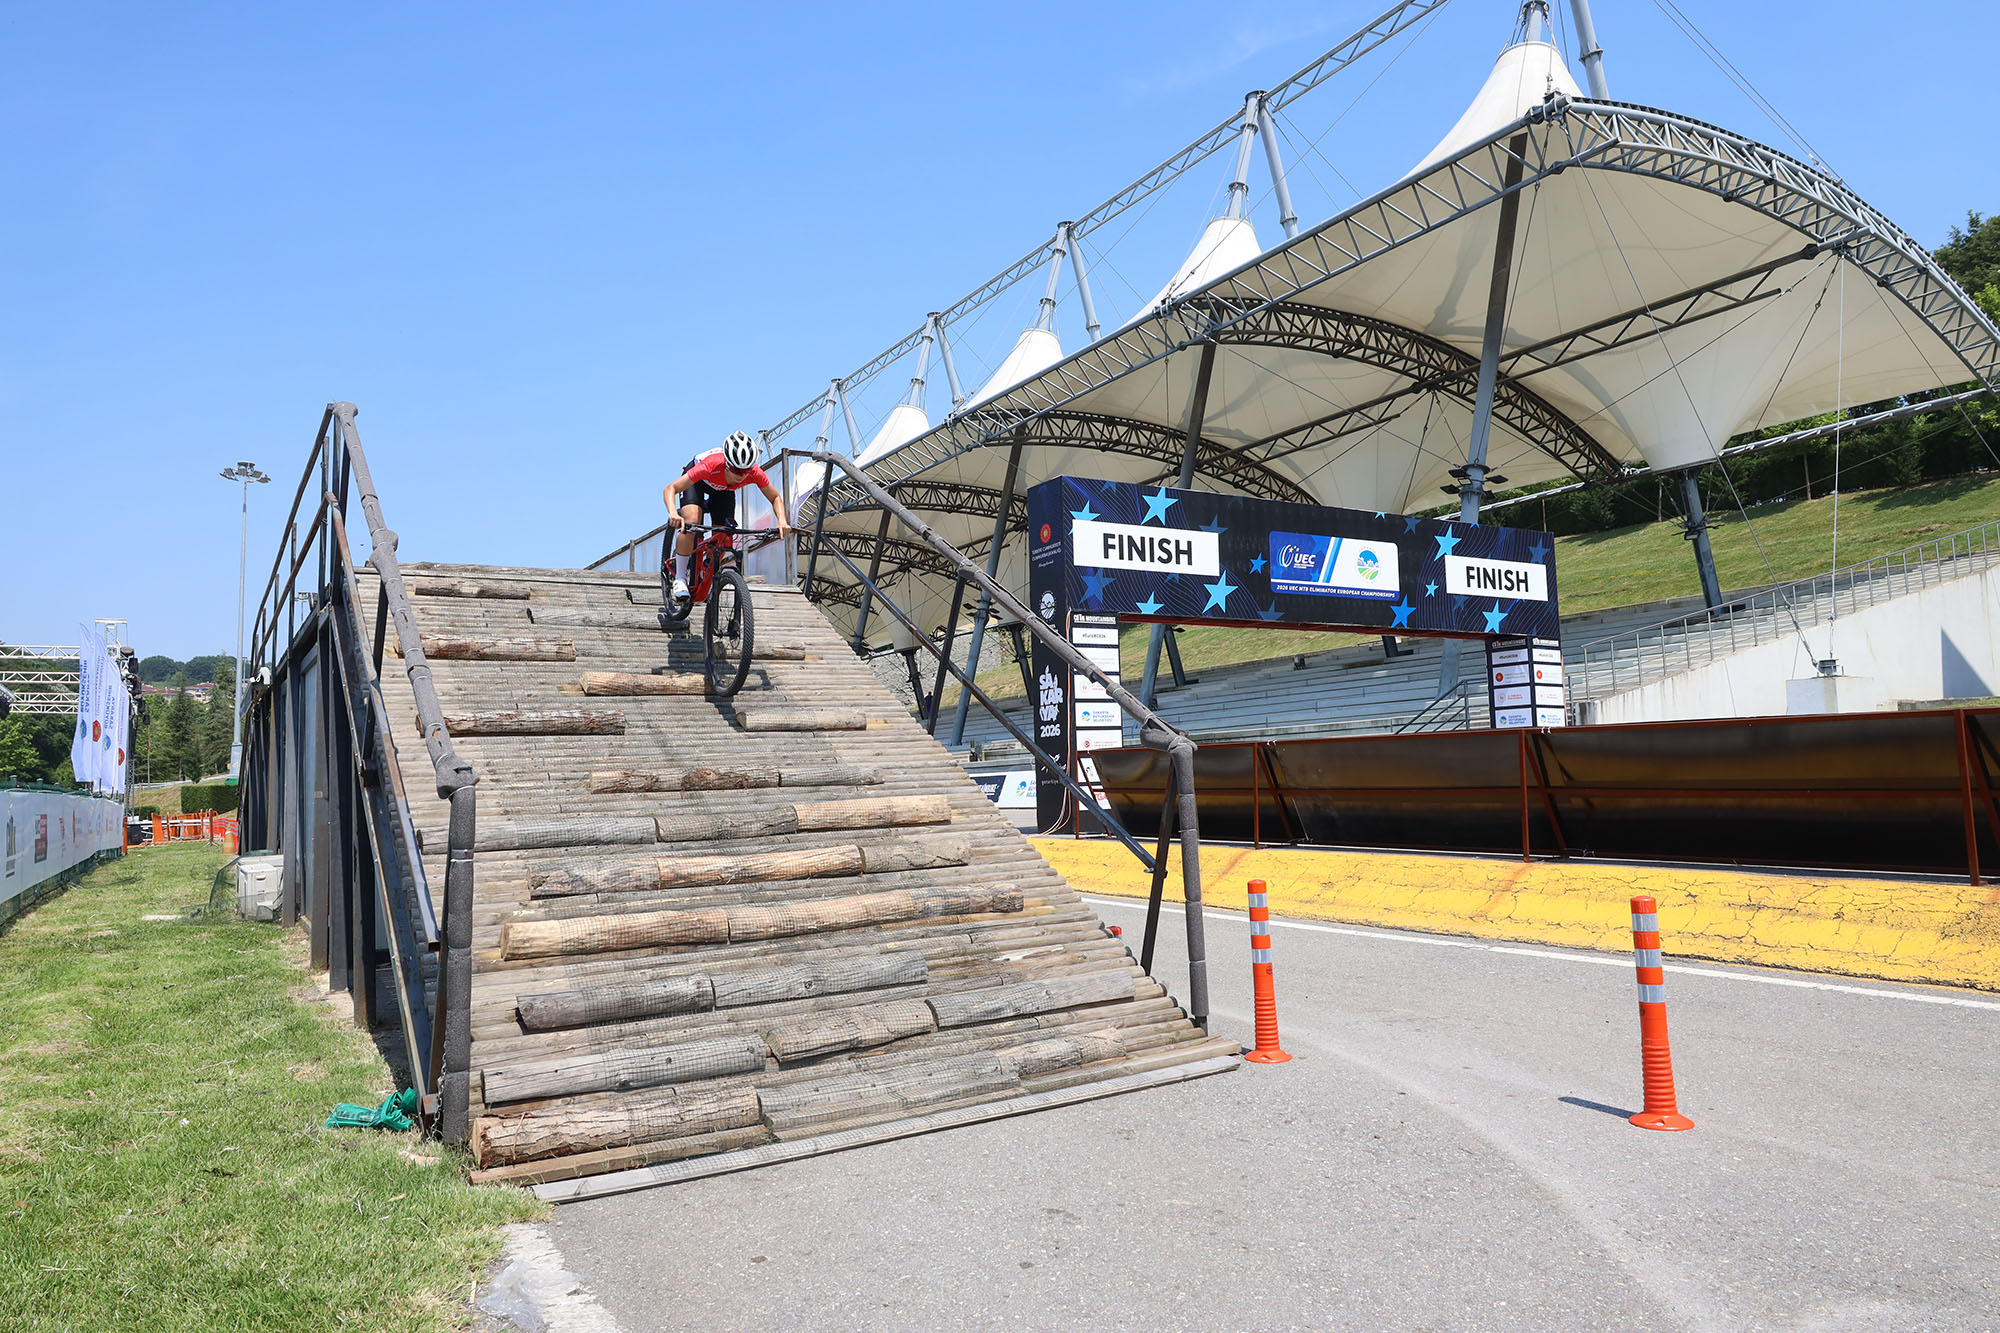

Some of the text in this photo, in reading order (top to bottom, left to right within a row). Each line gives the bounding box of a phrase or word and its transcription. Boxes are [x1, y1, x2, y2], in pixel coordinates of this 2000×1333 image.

[1103, 533, 1193, 566] FINISH
[1294, 553, 1316, 565] UEC
[1466, 566, 1529, 592] FINISH
[1361, 590, 1395, 598] CHAMPIONSHIPS
[1040, 723, 1061, 738] 2026
